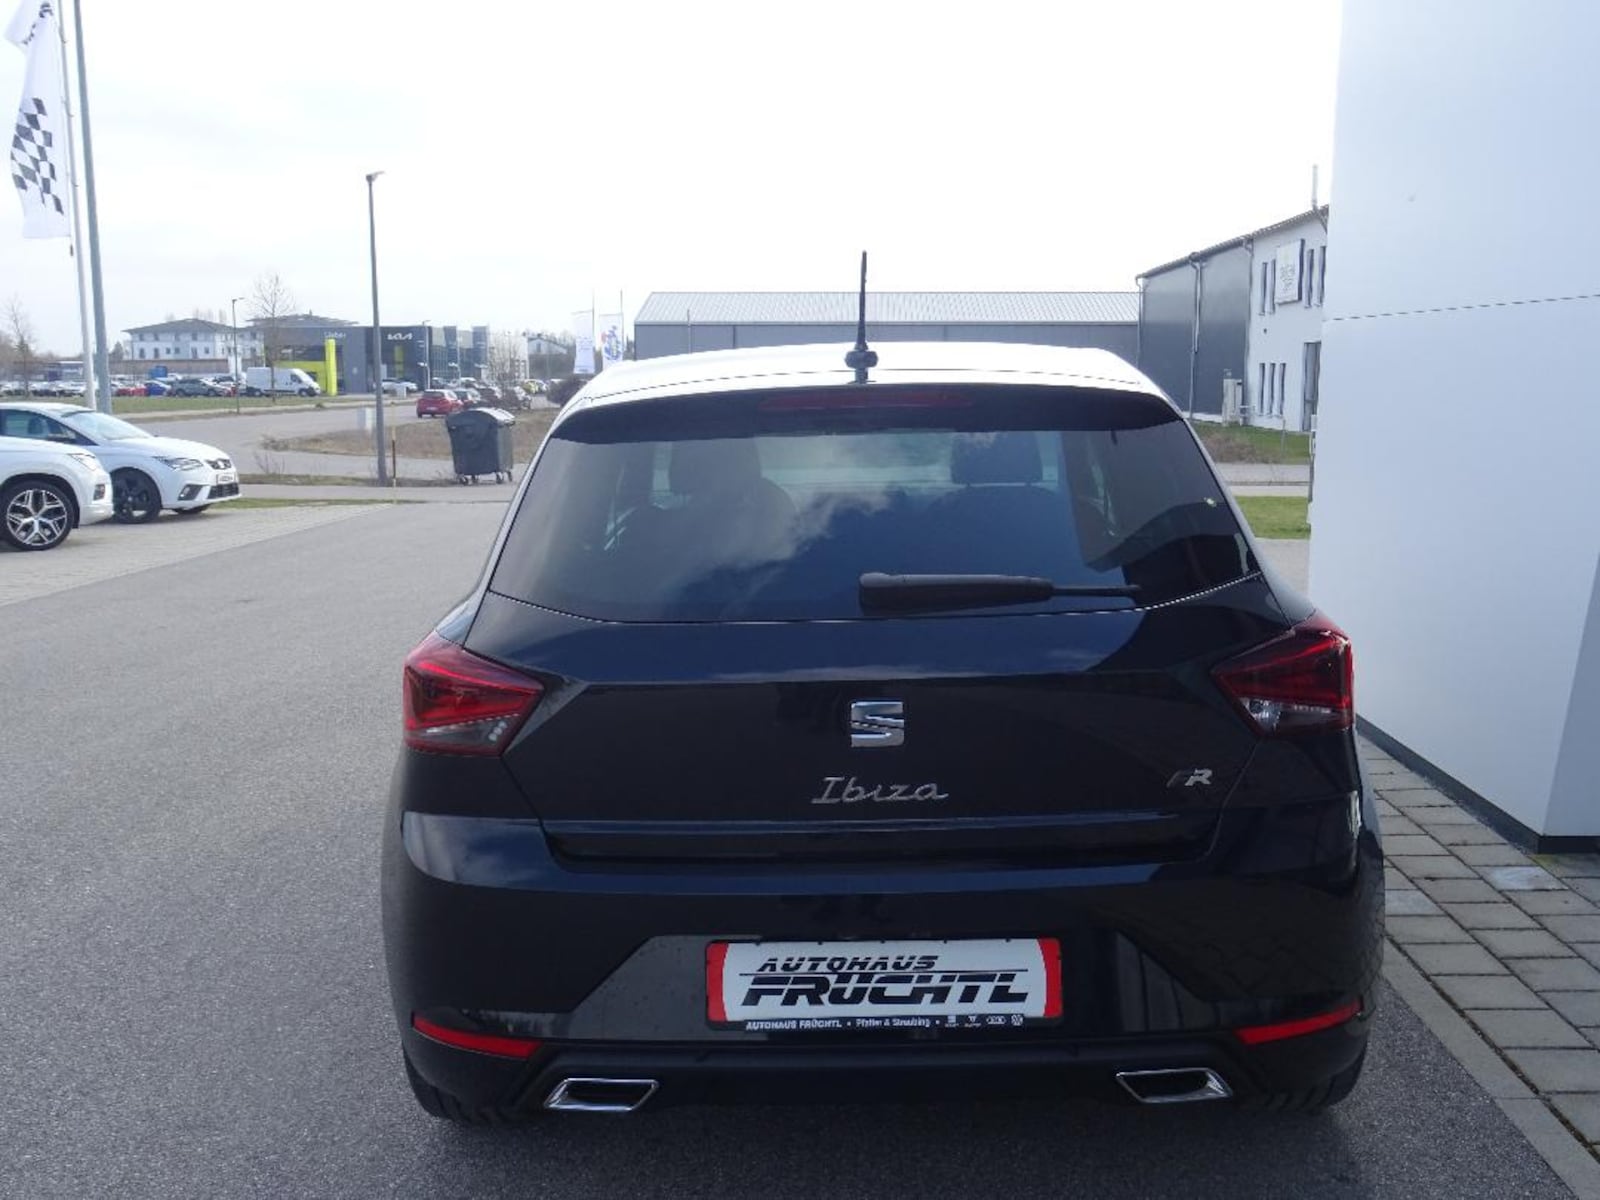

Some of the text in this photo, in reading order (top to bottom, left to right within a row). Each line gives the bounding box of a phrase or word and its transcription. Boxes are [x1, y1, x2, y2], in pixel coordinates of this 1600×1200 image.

[811, 776, 949, 804] Ibiza
[757, 955, 939, 973] AUTOHAUS
[746, 1020, 797, 1031] AUTOHAUS
[799, 1018, 843, 1030] FRÜCHTL
